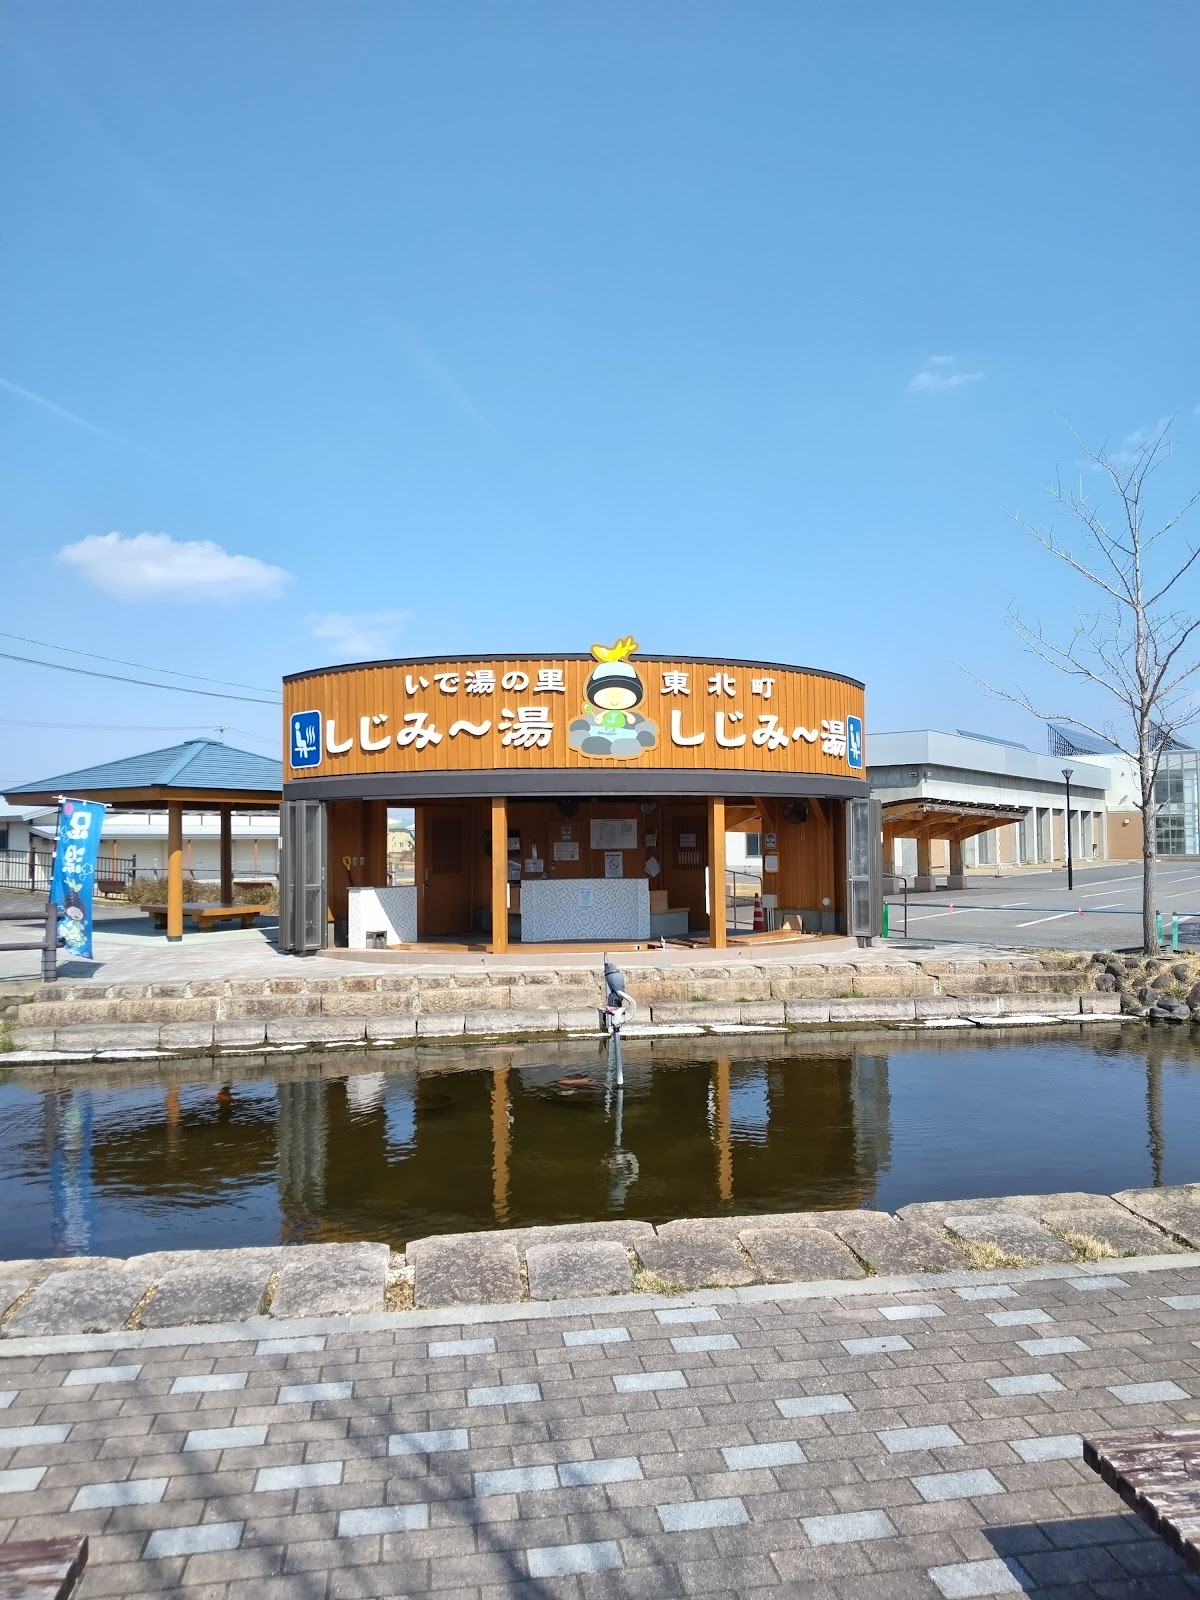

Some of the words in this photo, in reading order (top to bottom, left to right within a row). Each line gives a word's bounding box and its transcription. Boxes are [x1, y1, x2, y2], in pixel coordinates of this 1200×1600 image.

[405, 669, 567, 695] いで湯の里
[660, 669, 776, 699] 東北町
